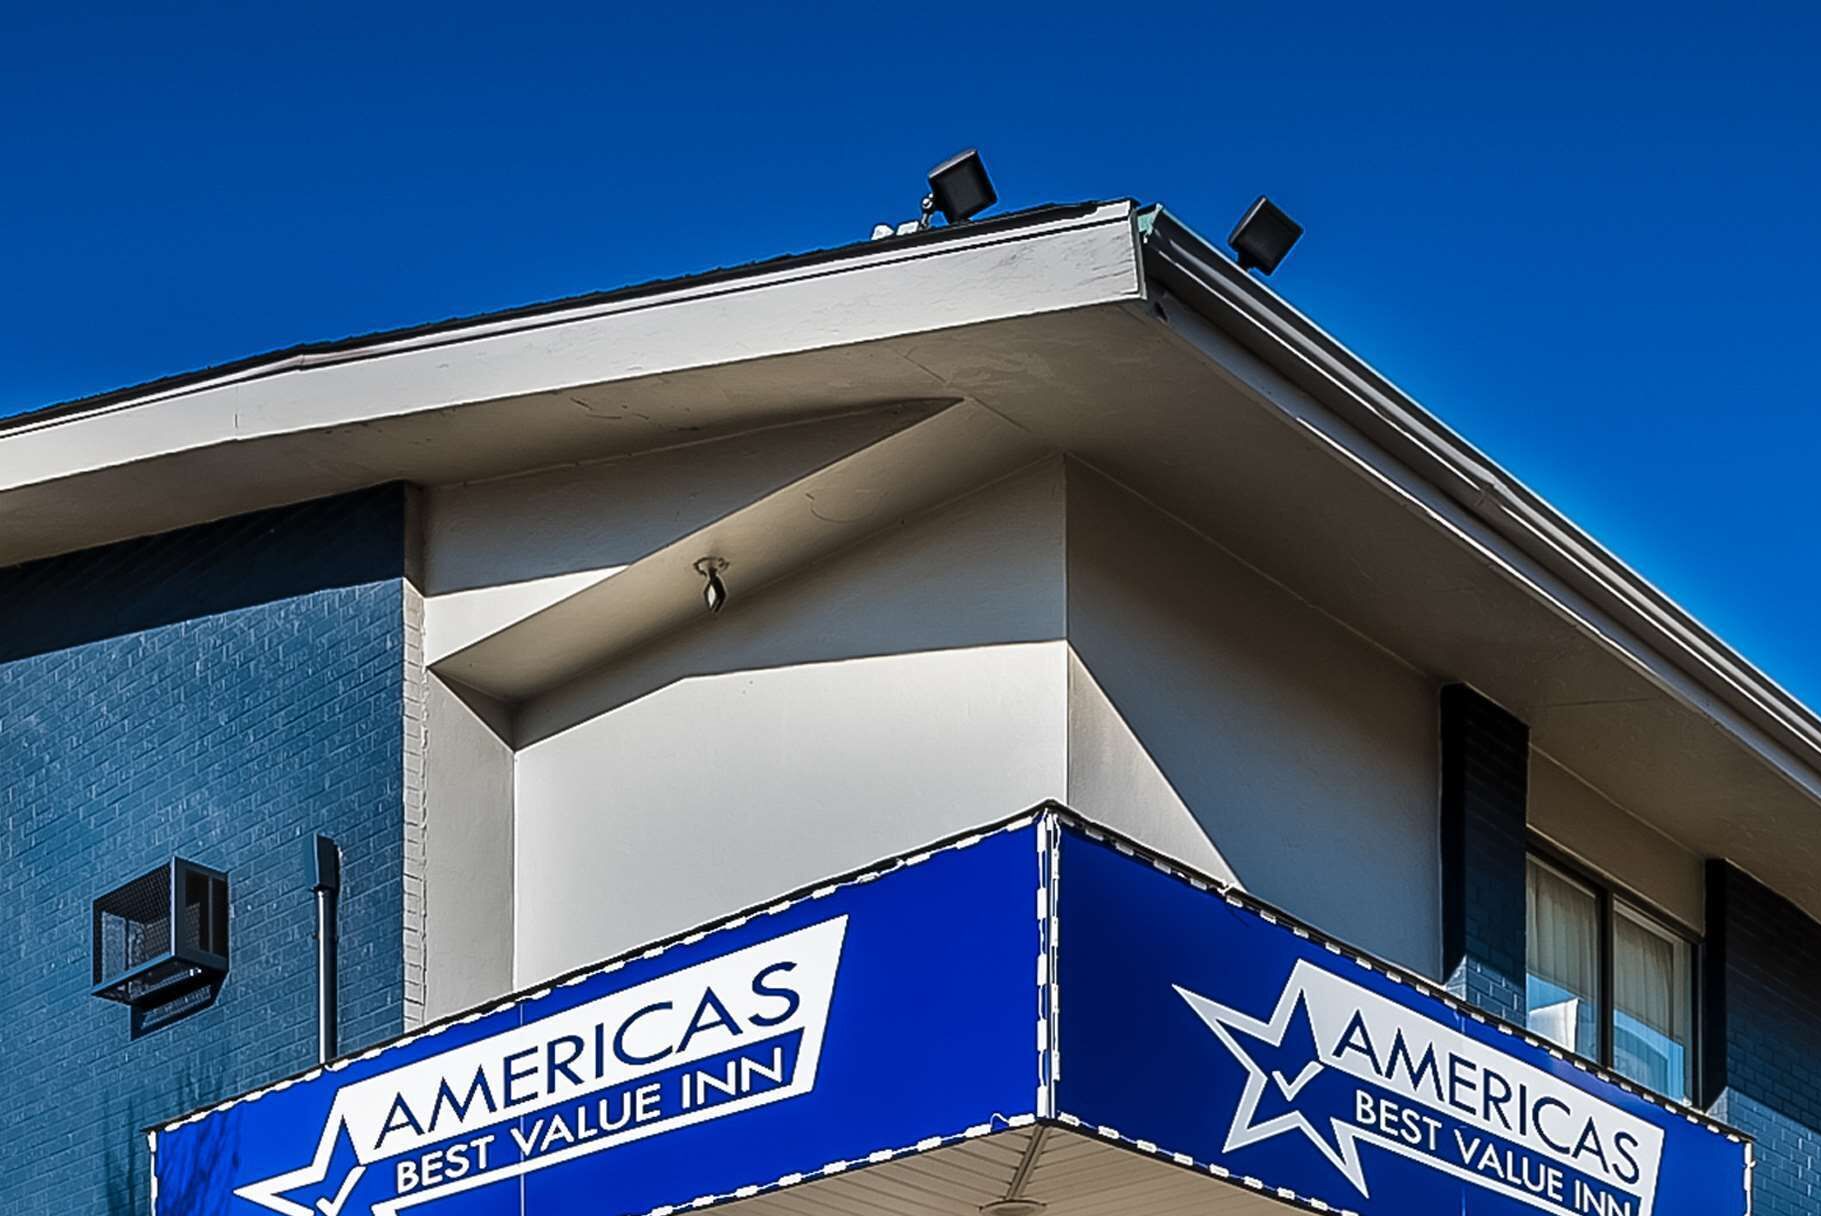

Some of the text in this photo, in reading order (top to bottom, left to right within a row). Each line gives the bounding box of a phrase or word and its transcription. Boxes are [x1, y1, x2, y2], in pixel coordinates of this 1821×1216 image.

[374, 960, 800, 1150] AMERICAS
[395, 1047, 784, 1194] BEST VALUE INN
[1332, 1009, 1641, 1185] AMERICAS
[1355, 1089, 1443, 1151] BEST
[1453, 1129, 1564, 1202] VALUE
